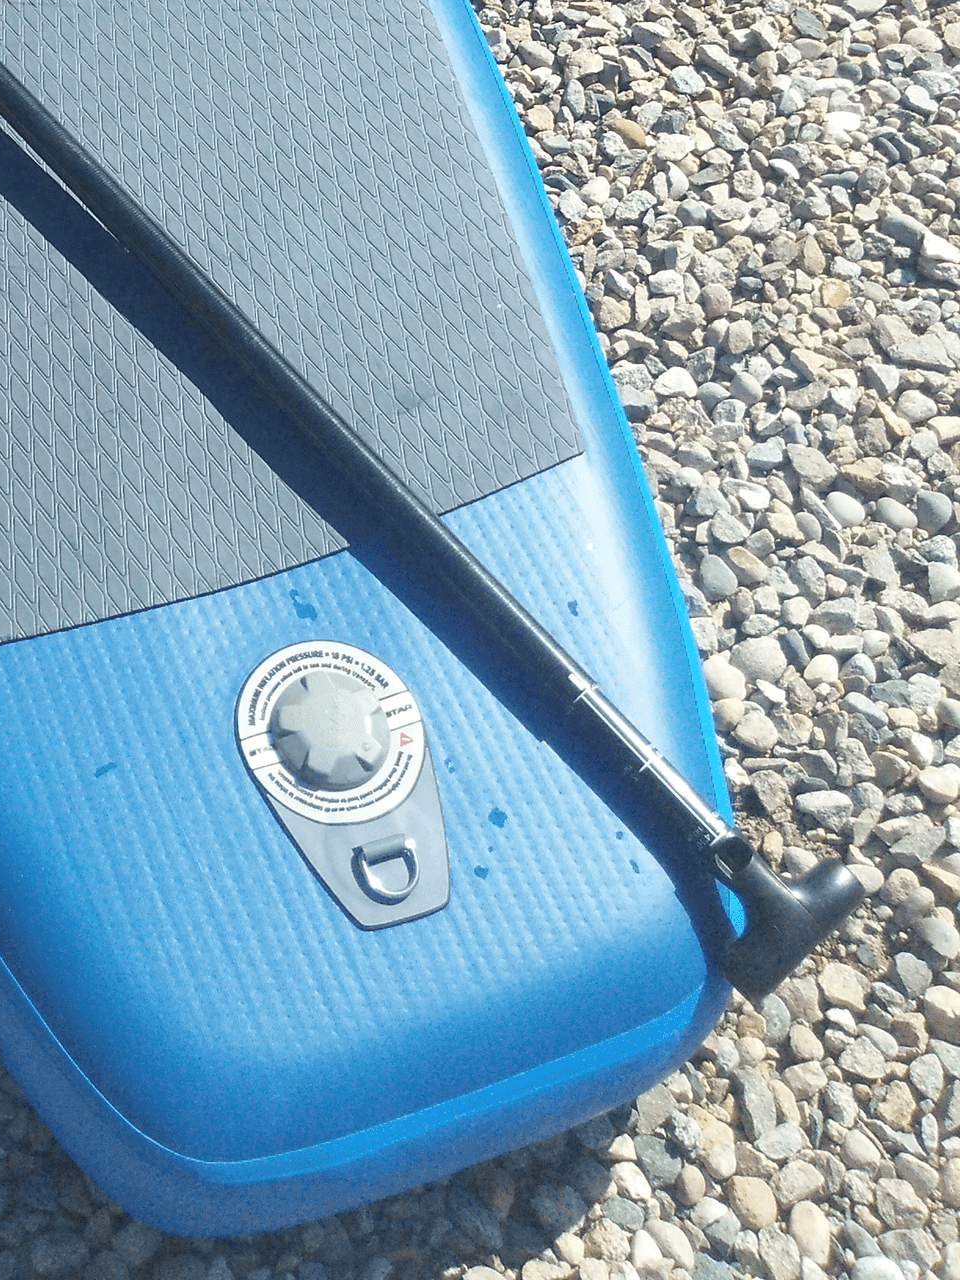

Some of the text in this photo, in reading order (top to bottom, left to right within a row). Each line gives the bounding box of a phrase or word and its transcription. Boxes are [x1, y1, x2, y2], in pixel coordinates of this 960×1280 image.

[248, 688, 262, 726] MAXIMUM
[257, 660, 287, 690] INFLATION
[285, 650, 324, 665] PRESSURE
[341, 654, 354, 664] PSI
[360, 663, 376, 676] 1.25
[374, 673, 389, 689] BAR
